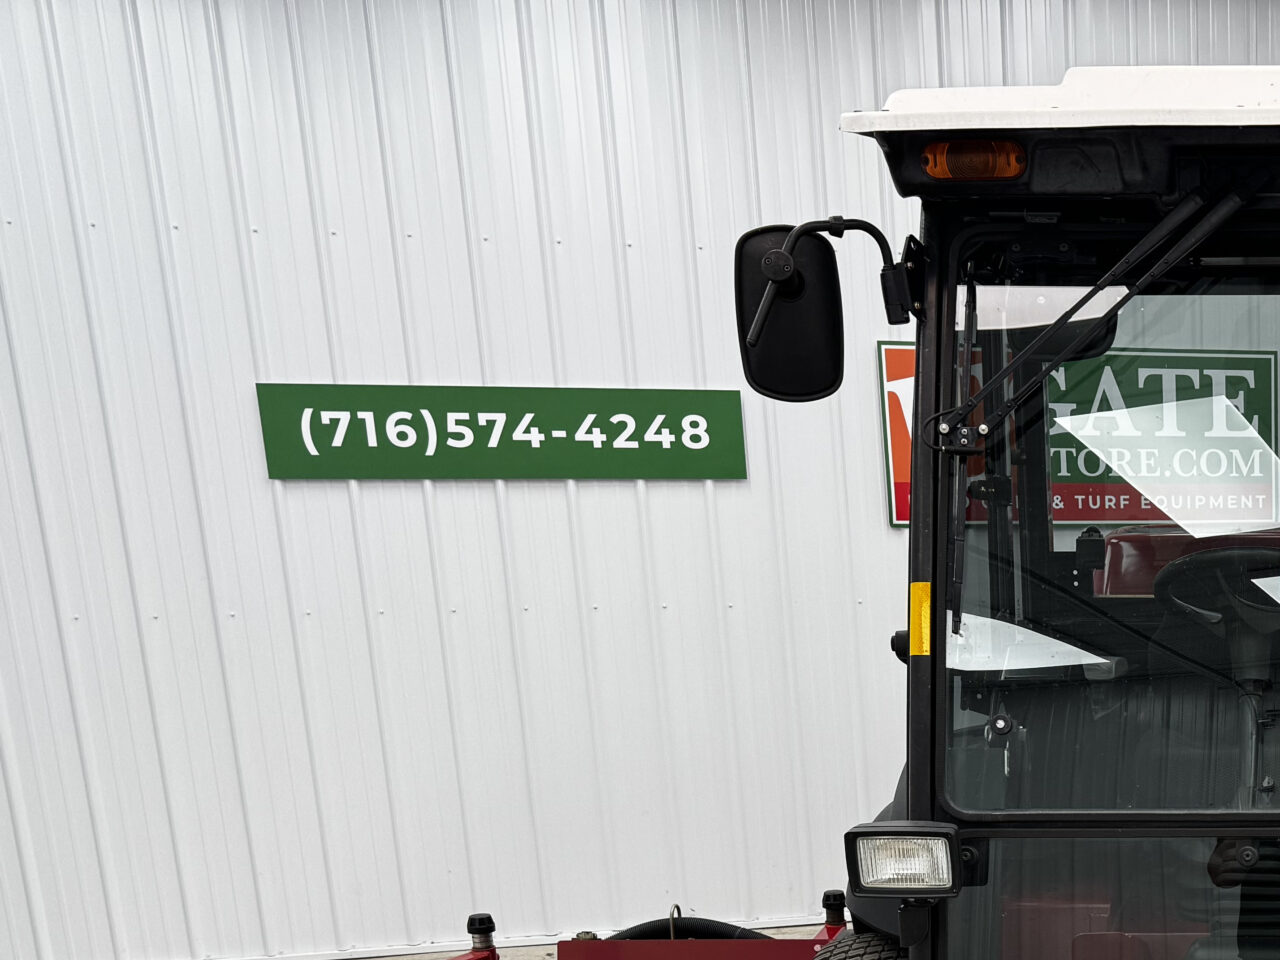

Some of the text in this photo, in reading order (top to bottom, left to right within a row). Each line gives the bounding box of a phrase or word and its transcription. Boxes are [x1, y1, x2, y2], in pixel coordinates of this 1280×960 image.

[300, 408, 711, 456] (716)574-4248
[1050, 448, 1264, 477] TORE.COM
[1052, 495, 1267, 510] & TURF EQUIPMENT
